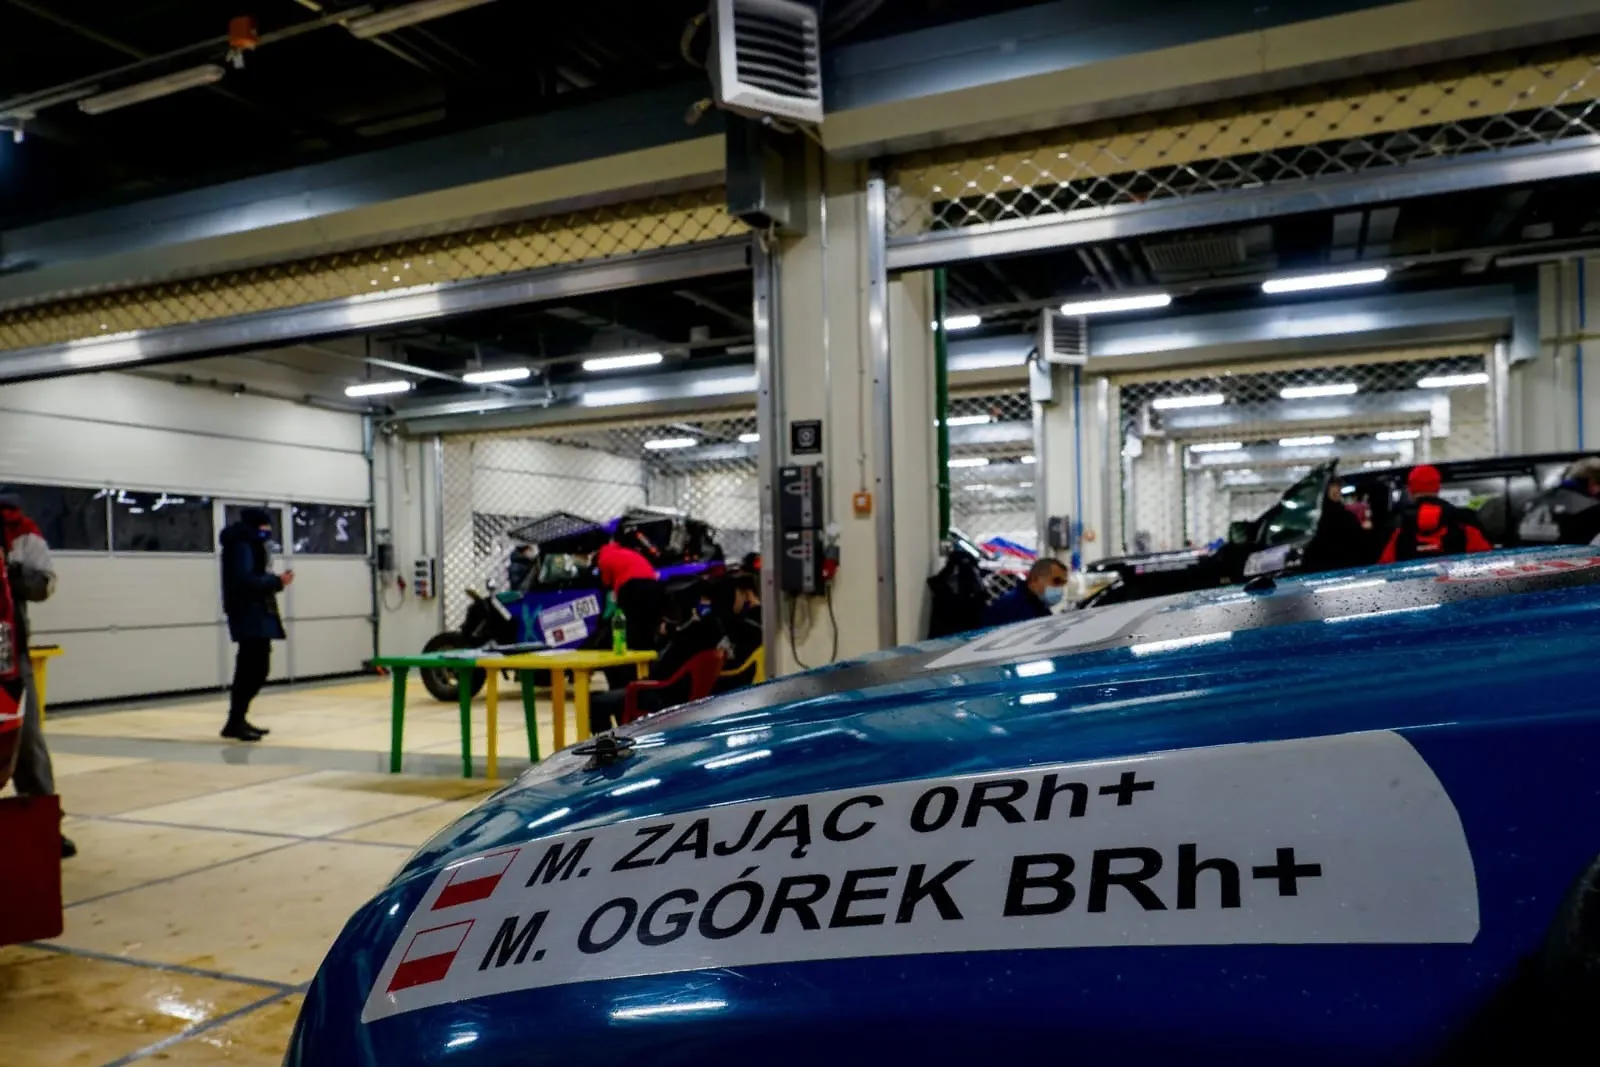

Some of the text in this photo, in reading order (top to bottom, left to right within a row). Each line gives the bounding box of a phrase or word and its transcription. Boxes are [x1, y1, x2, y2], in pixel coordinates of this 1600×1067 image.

[525, 838, 591, 887] M.
[611, 795, 884, 859] ZAJĄC
[478, 839, 1322, 971] M. OGÓREK BRh+
